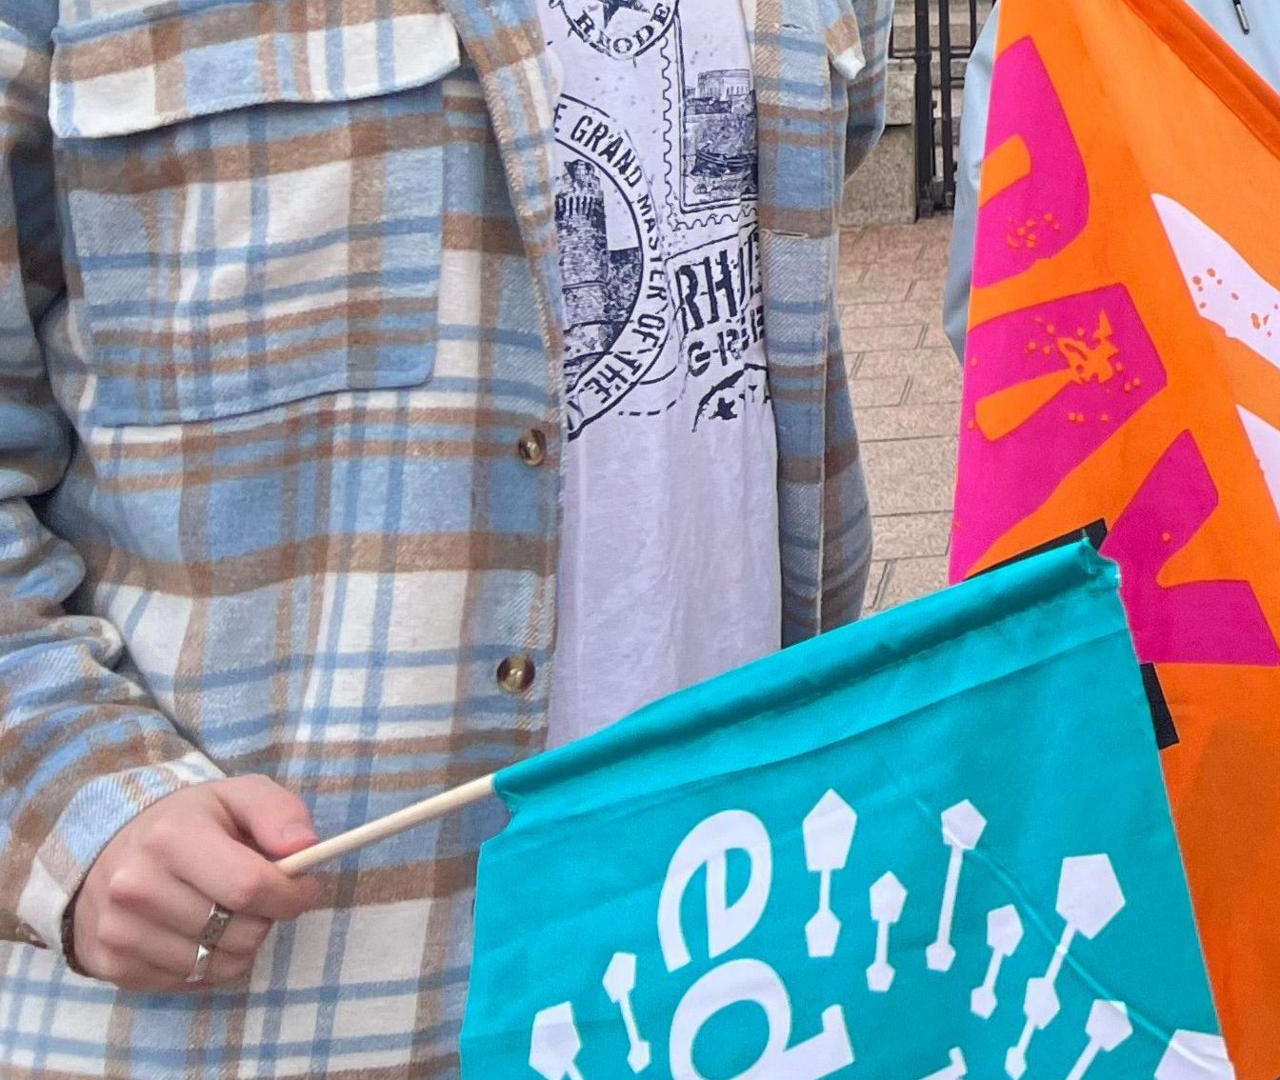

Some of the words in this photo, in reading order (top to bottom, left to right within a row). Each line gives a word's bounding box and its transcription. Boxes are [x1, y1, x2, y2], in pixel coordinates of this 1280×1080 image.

[569, 114, 643, 188] GRAND
[637, 193, 667, 301] MASTER
[631, 313, 666, 349] OF
[583, 352, 643, 404] THE
